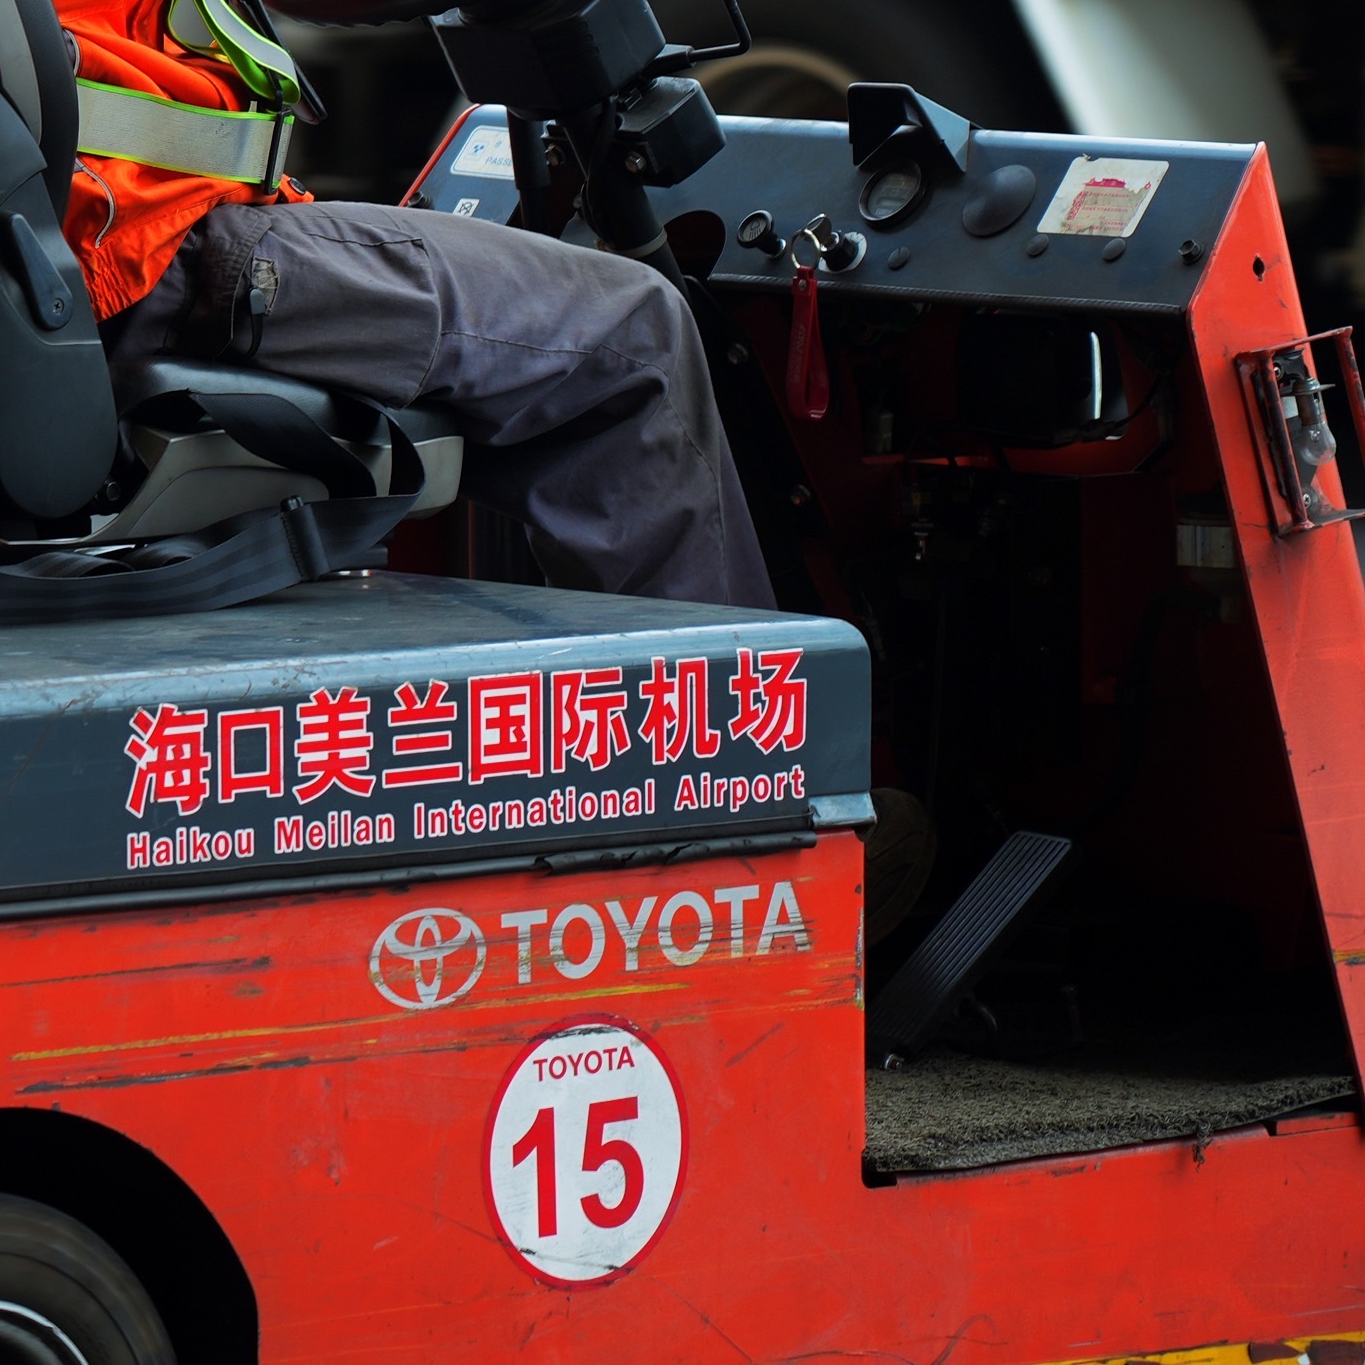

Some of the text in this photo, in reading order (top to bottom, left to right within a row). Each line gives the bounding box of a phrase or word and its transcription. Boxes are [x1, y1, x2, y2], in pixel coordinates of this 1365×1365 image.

[124, 647, 810, 818] 海口美兰国际机场
[126, 764, 807, 870] Haikou Meilan International Airport
[500, 880, 812, 986] TOYOTA
[533, 1044, 636, 1083] TOYOTA
[511, 1095, 646, 1239] 15
